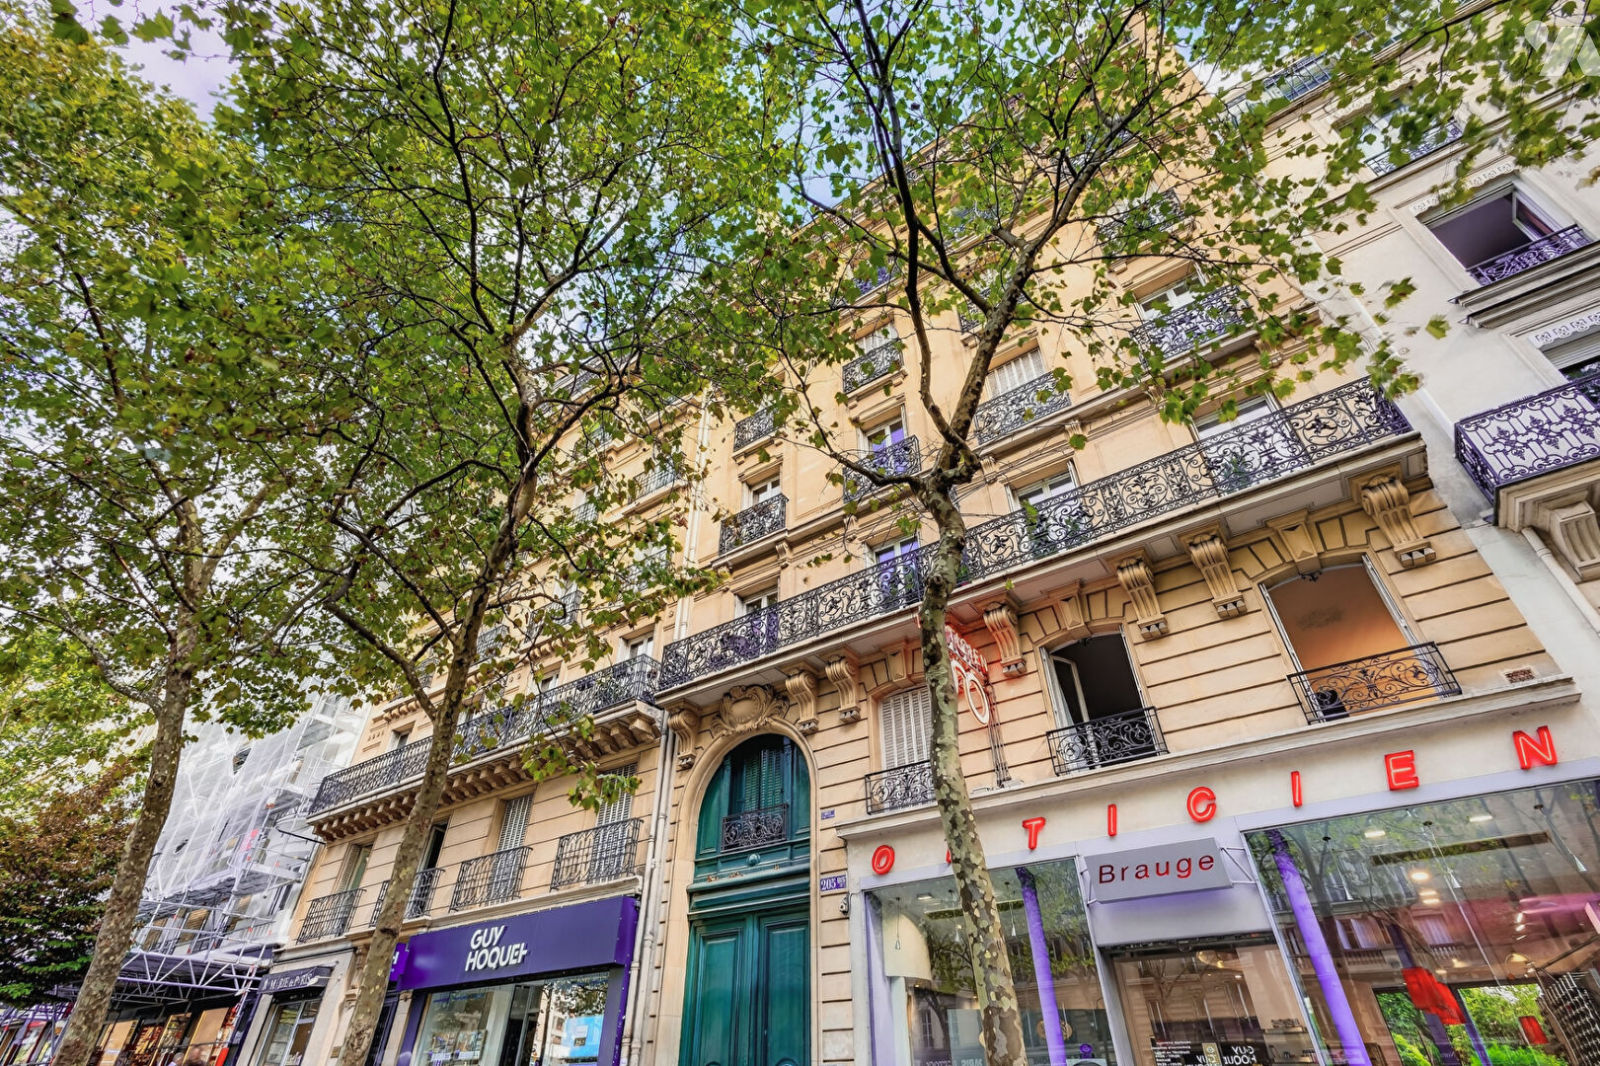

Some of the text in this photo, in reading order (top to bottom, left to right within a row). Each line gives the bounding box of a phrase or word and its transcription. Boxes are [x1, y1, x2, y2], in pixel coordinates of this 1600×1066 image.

[871, 725, 1559, 876] OTICIEN
[820, 877, 836, 890] 205
[1099, 855, 1214, 884] Brauge
[471, 925, 505, 950] GUY
[465, 943, 528, 972] HOQUET
